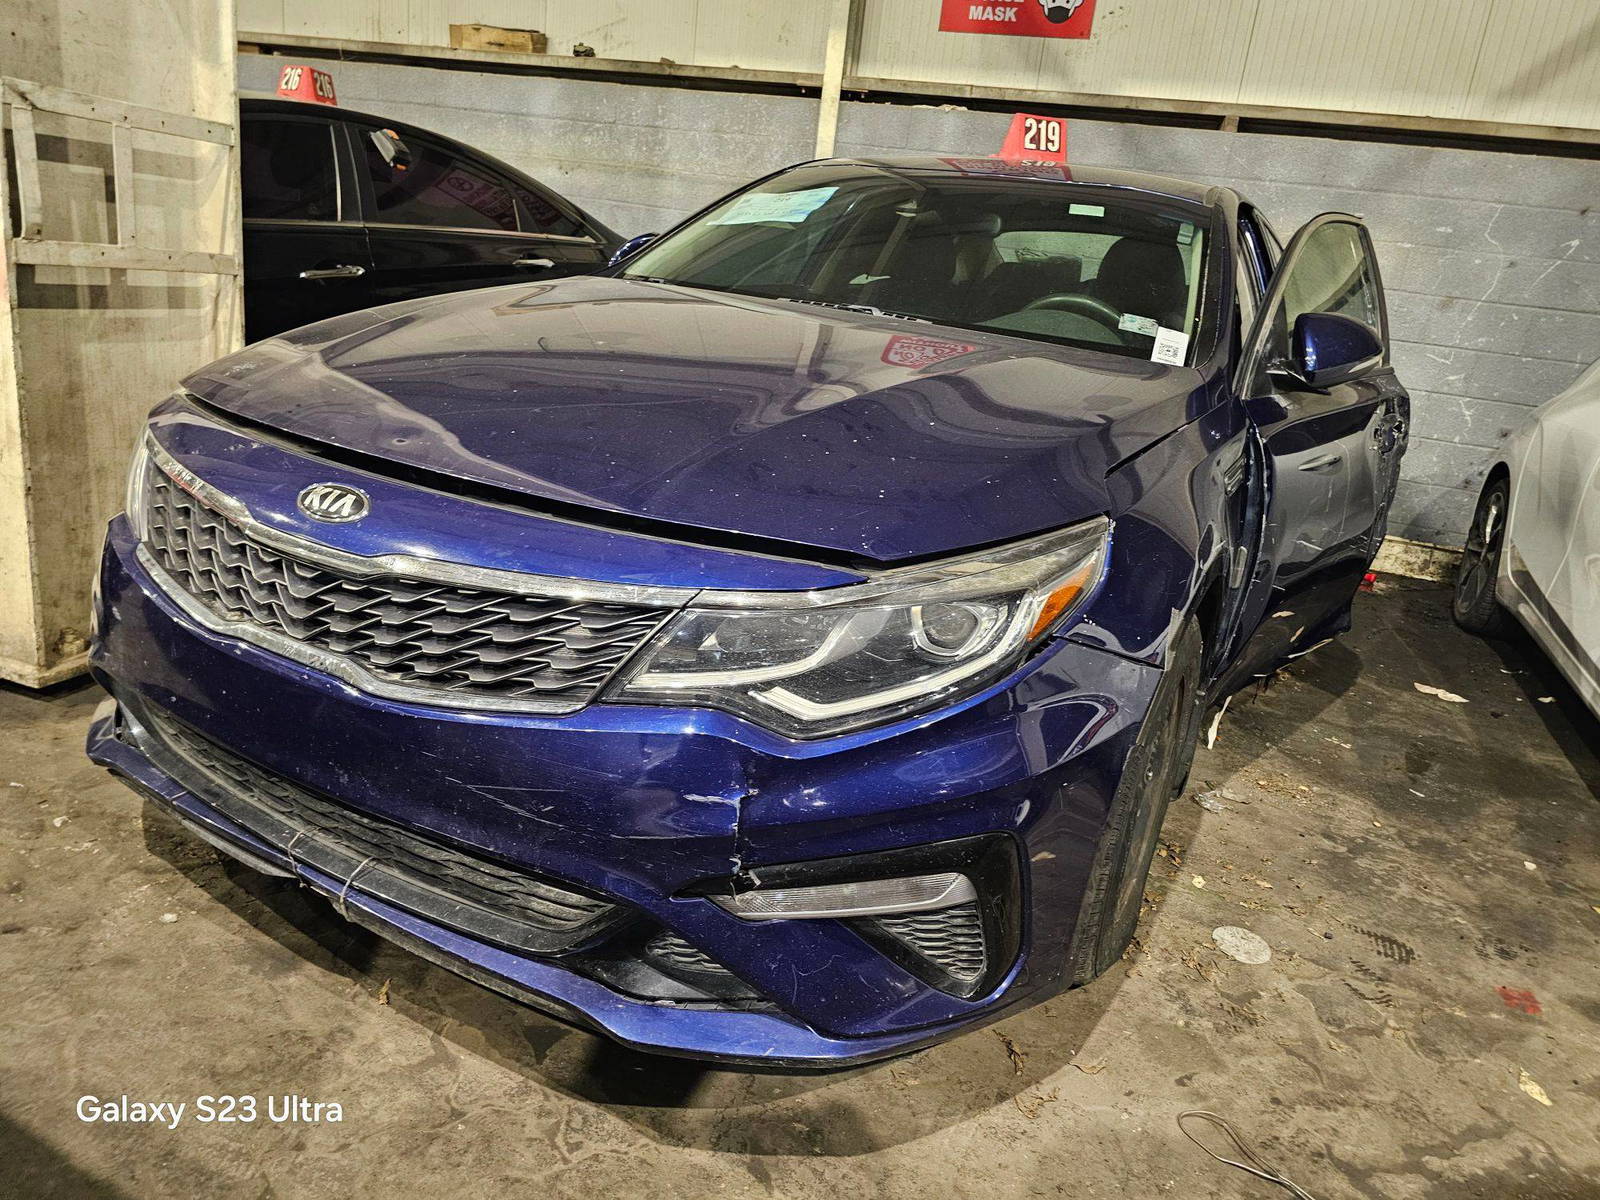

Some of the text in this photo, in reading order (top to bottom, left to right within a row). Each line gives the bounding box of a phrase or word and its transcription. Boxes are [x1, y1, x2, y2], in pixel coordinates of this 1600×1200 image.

[968, 5, 1018, 22] MASK
[280, 67, 302, 91] 216
[313, 71, 334, 99] 216
[1023, 117, 1060, 152] 219
[303, 486, 357, 517] KIA
